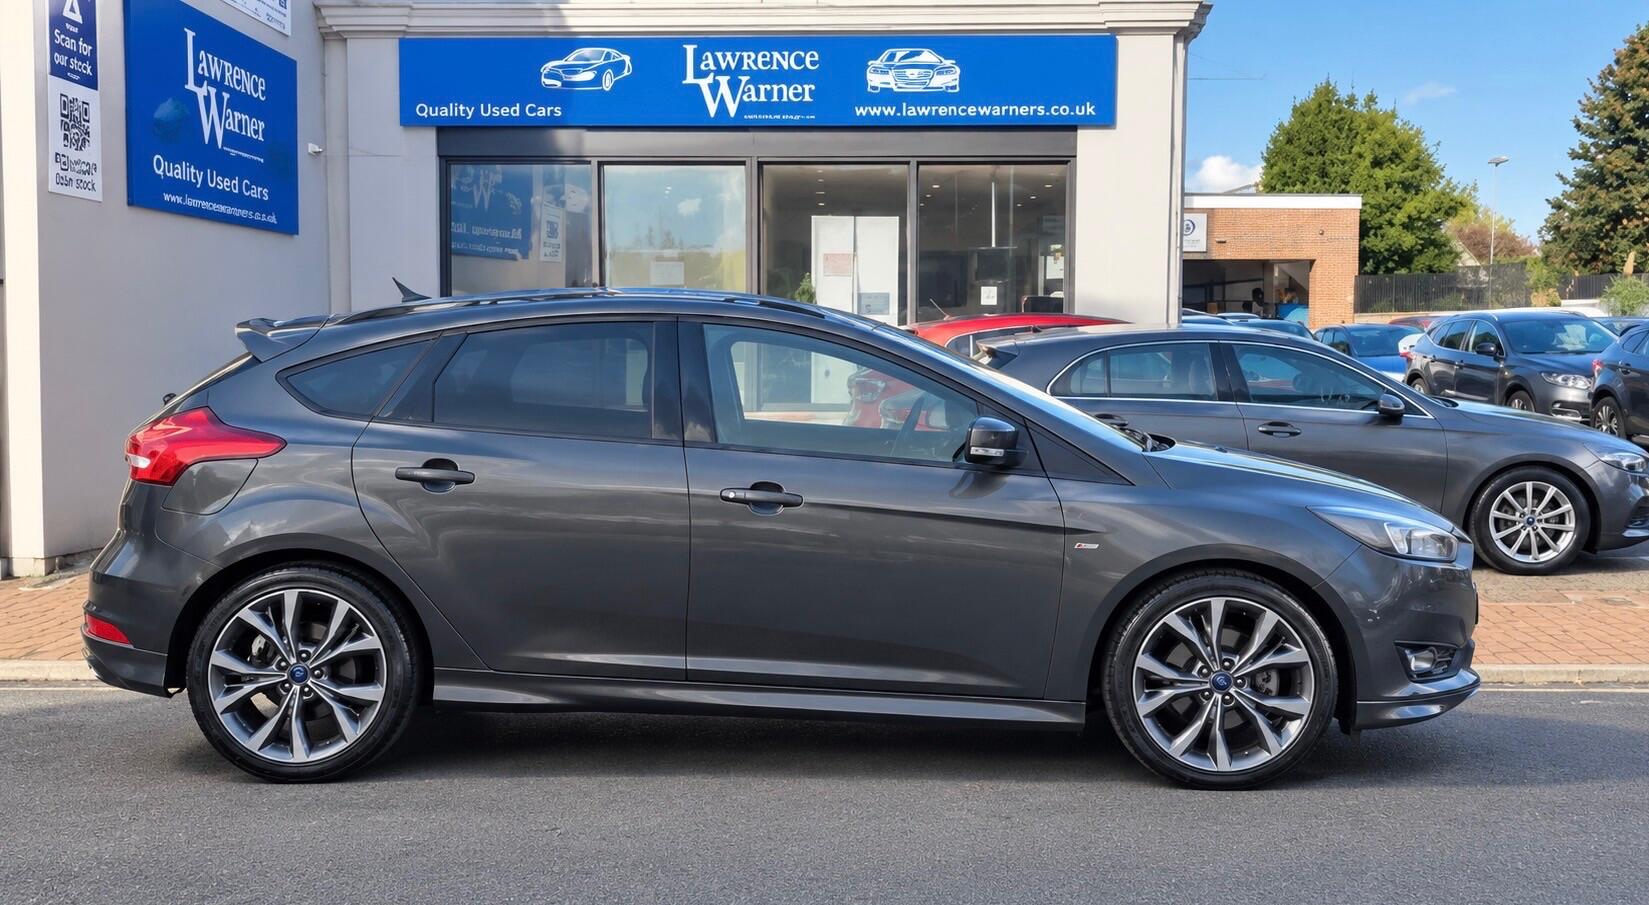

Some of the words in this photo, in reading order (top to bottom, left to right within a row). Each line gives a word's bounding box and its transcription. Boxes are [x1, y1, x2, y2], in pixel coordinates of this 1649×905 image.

[54, 28, 77, 52] Scan
[79, 37, 93, 57] for
[69, 57, 93, 76] stock
[415, 103, 475, 119] Quality
[480, 103, 520, 117] Used
[525, 103, 563, 117] Cars
[854, 102, 1097, 117] www.lawrencewarners.co.uk
[152, 154, 204, 189] Quality
[207, 168, 239, 194] Used
[242, 179, 270, 201] Cars
